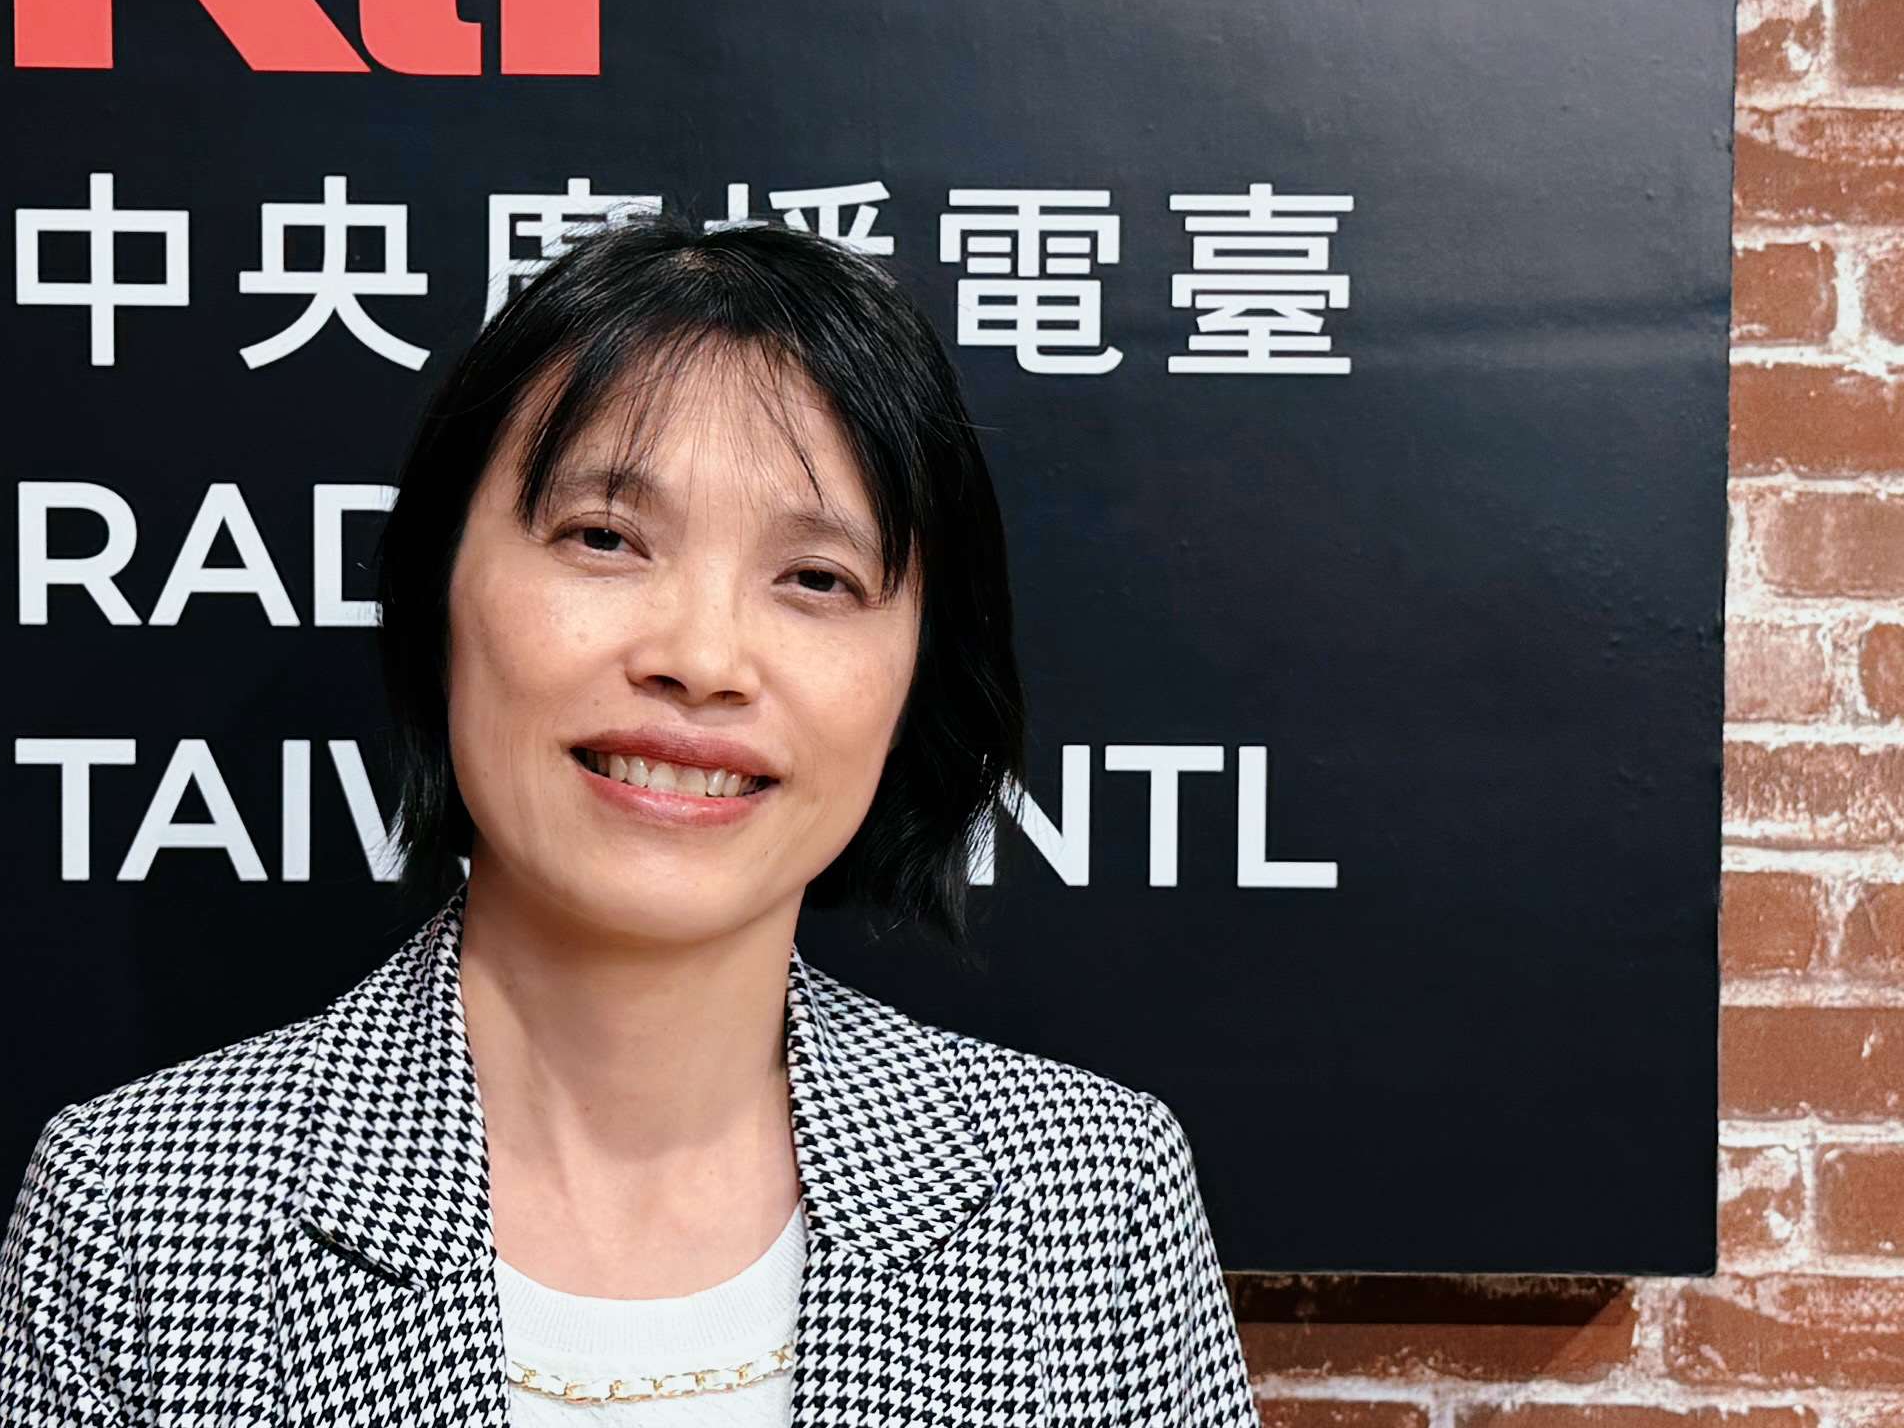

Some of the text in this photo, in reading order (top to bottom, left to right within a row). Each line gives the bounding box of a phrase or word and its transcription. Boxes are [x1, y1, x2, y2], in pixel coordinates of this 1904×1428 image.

[18, 481, 401, 627] RAD
[15, 738, 1338, 887] TAI NTL
